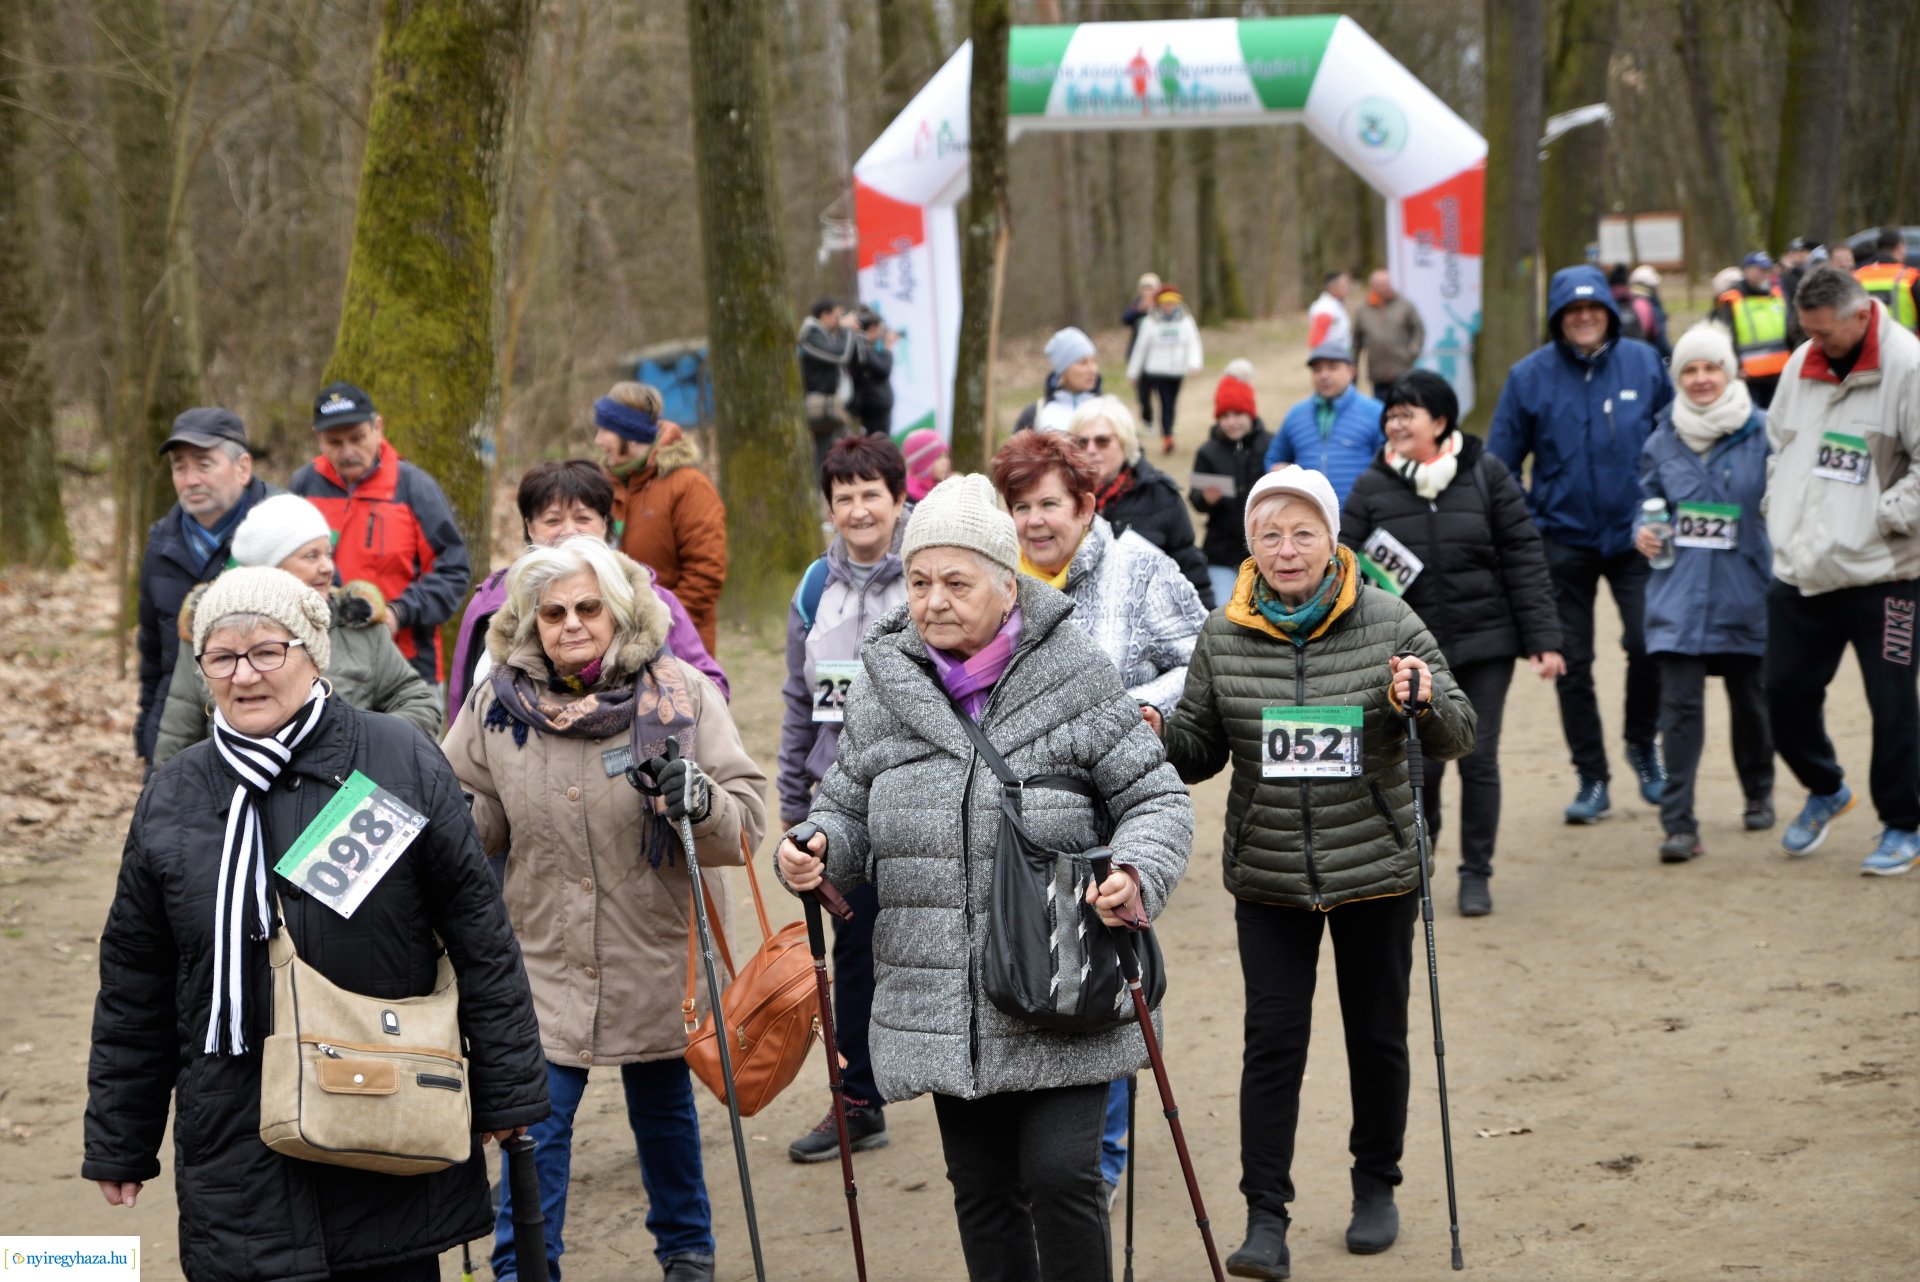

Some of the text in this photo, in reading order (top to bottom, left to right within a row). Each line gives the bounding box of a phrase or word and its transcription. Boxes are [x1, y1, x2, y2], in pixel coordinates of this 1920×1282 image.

[1819, 446, 1861, 470] 033
[1681, 517, 1725, 537] 032
[1372, 545, 1411, 584] 046
[1883, 596, 1916, 666] NIKE
[1268, 728, 1344, 761] 052
[307, 809, 394, 897] 098
